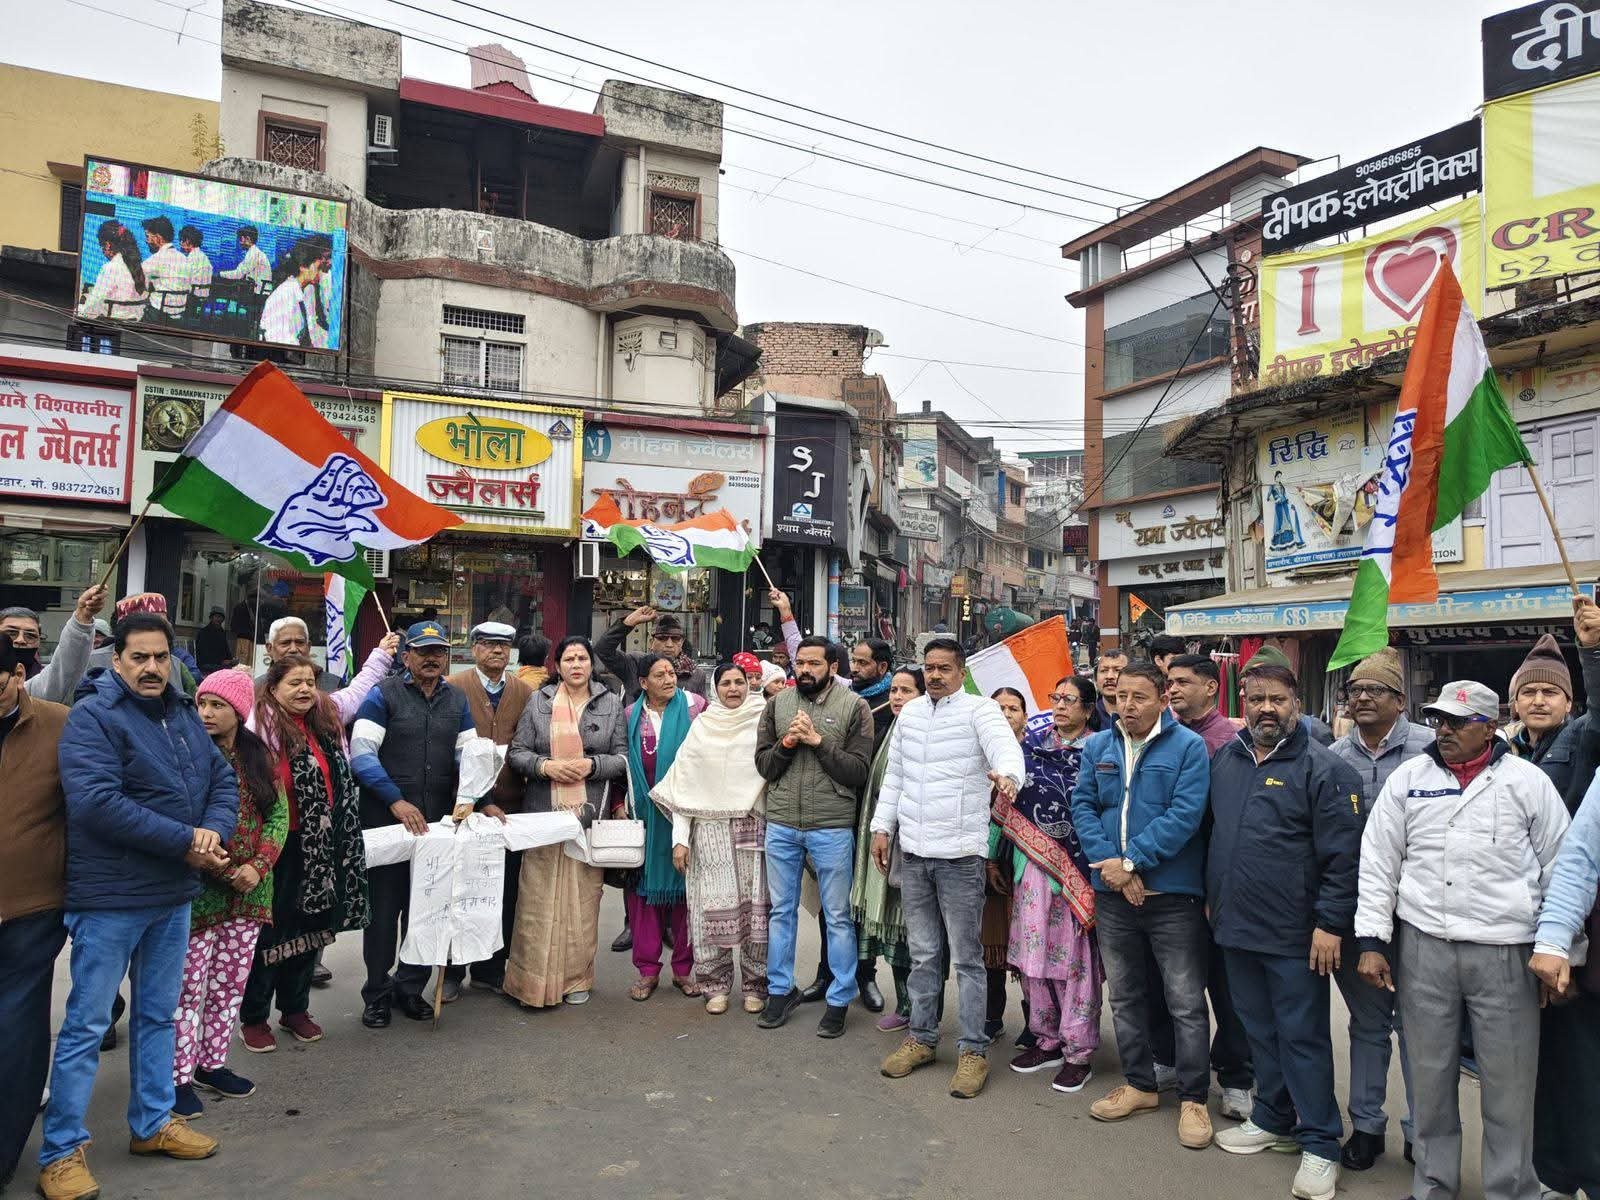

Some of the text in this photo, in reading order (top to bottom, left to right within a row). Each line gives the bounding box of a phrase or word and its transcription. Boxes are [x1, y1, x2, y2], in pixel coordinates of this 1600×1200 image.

[1355, 145, 1422, 178] 9058686865
[1262, 189, 1341, 241] दीपक
[1297, 266, 1320, 336] I
[34, 393, 123, 418] विश्वसनीय
[145, 385, 164, 395] GSTIN
[37, 417, 120, 468] ज्वैलर्स
[445, 411, 525, 463] भोला
[52, 481, 120, 496] 9837272651
[788, 446, 813, 472] S
[804, 471, 825, 498] J
[776, 523, 800, 534] श्याम
[1433, 549, 1456, 559] TION
